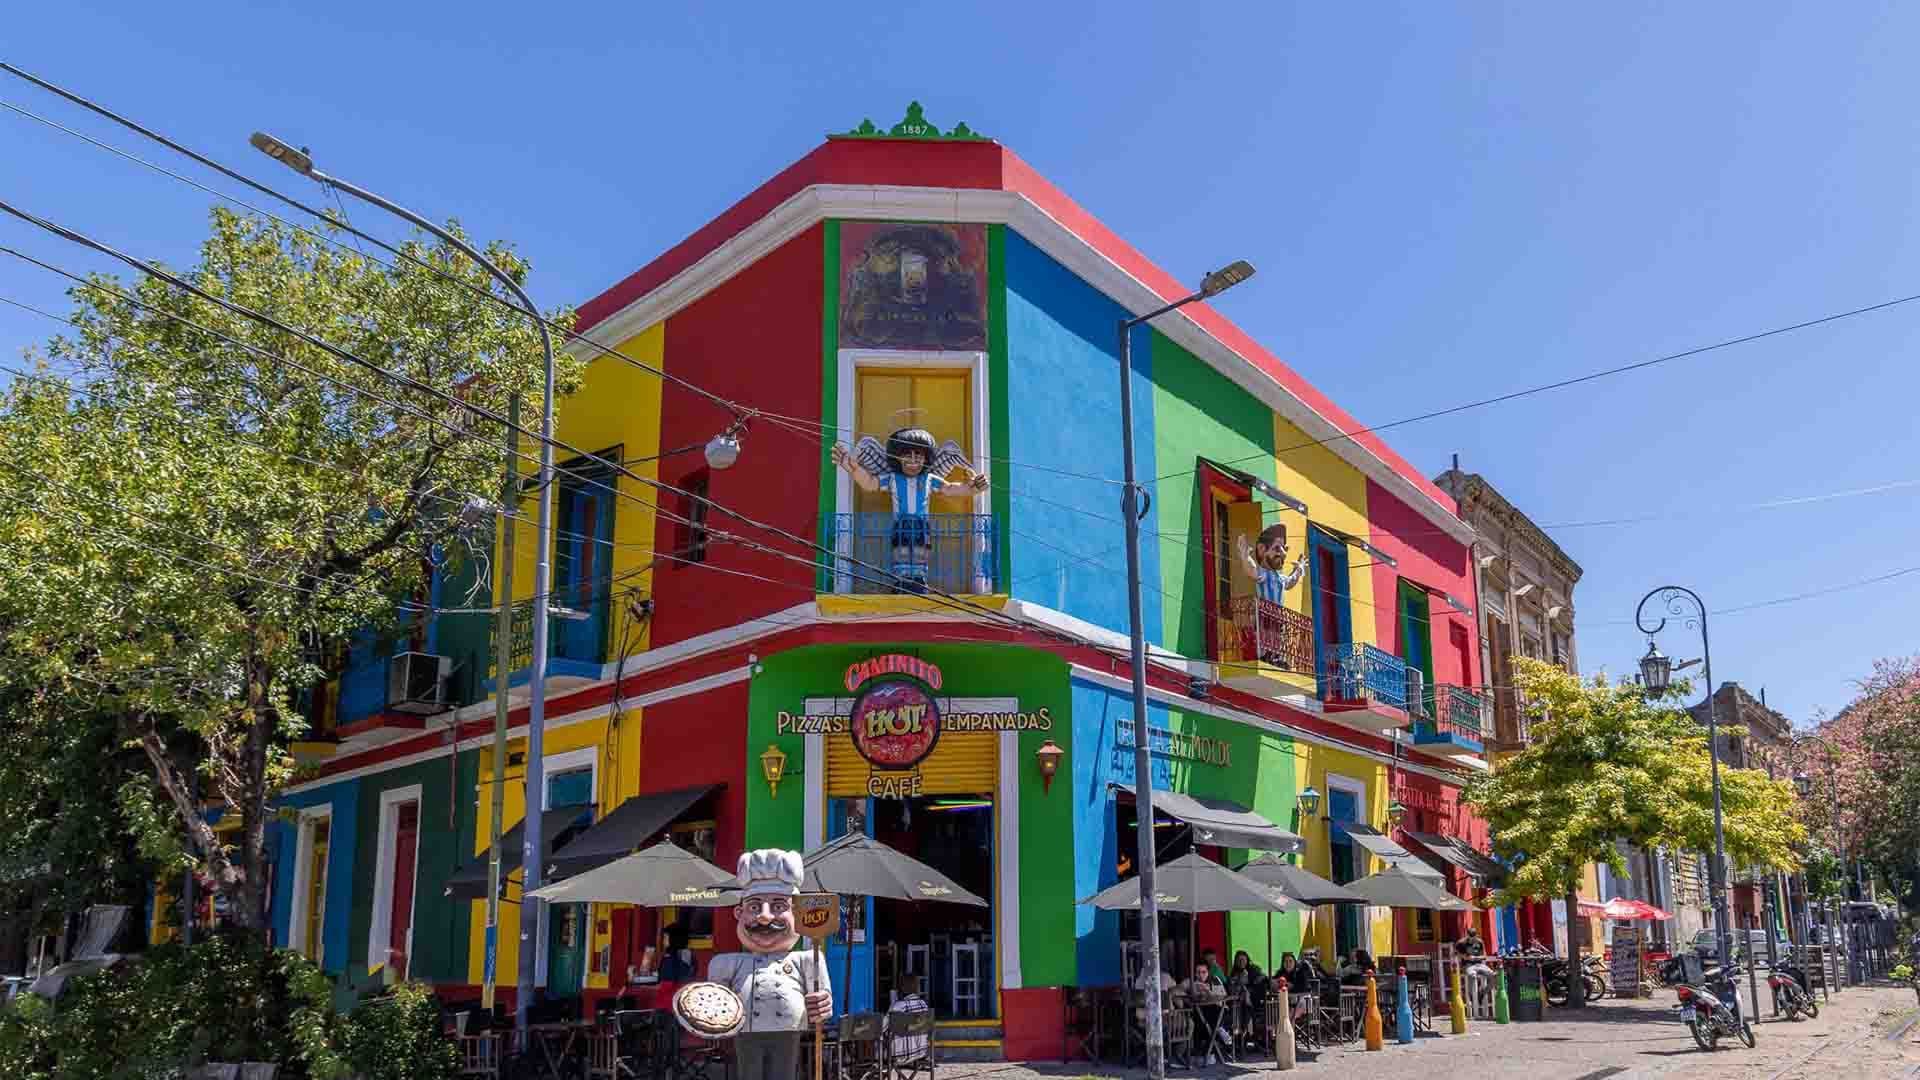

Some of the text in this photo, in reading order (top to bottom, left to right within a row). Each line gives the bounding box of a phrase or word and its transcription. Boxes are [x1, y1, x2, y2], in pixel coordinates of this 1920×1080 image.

[903, 124, 928, 136] 1887
[845, 654, 943, 692] CAMINITO
[777, 711, 843, 735] PIZZAS
[865, 703, 926, 737] HOT
[947, 707, 1052, 731] EMPANADAS
